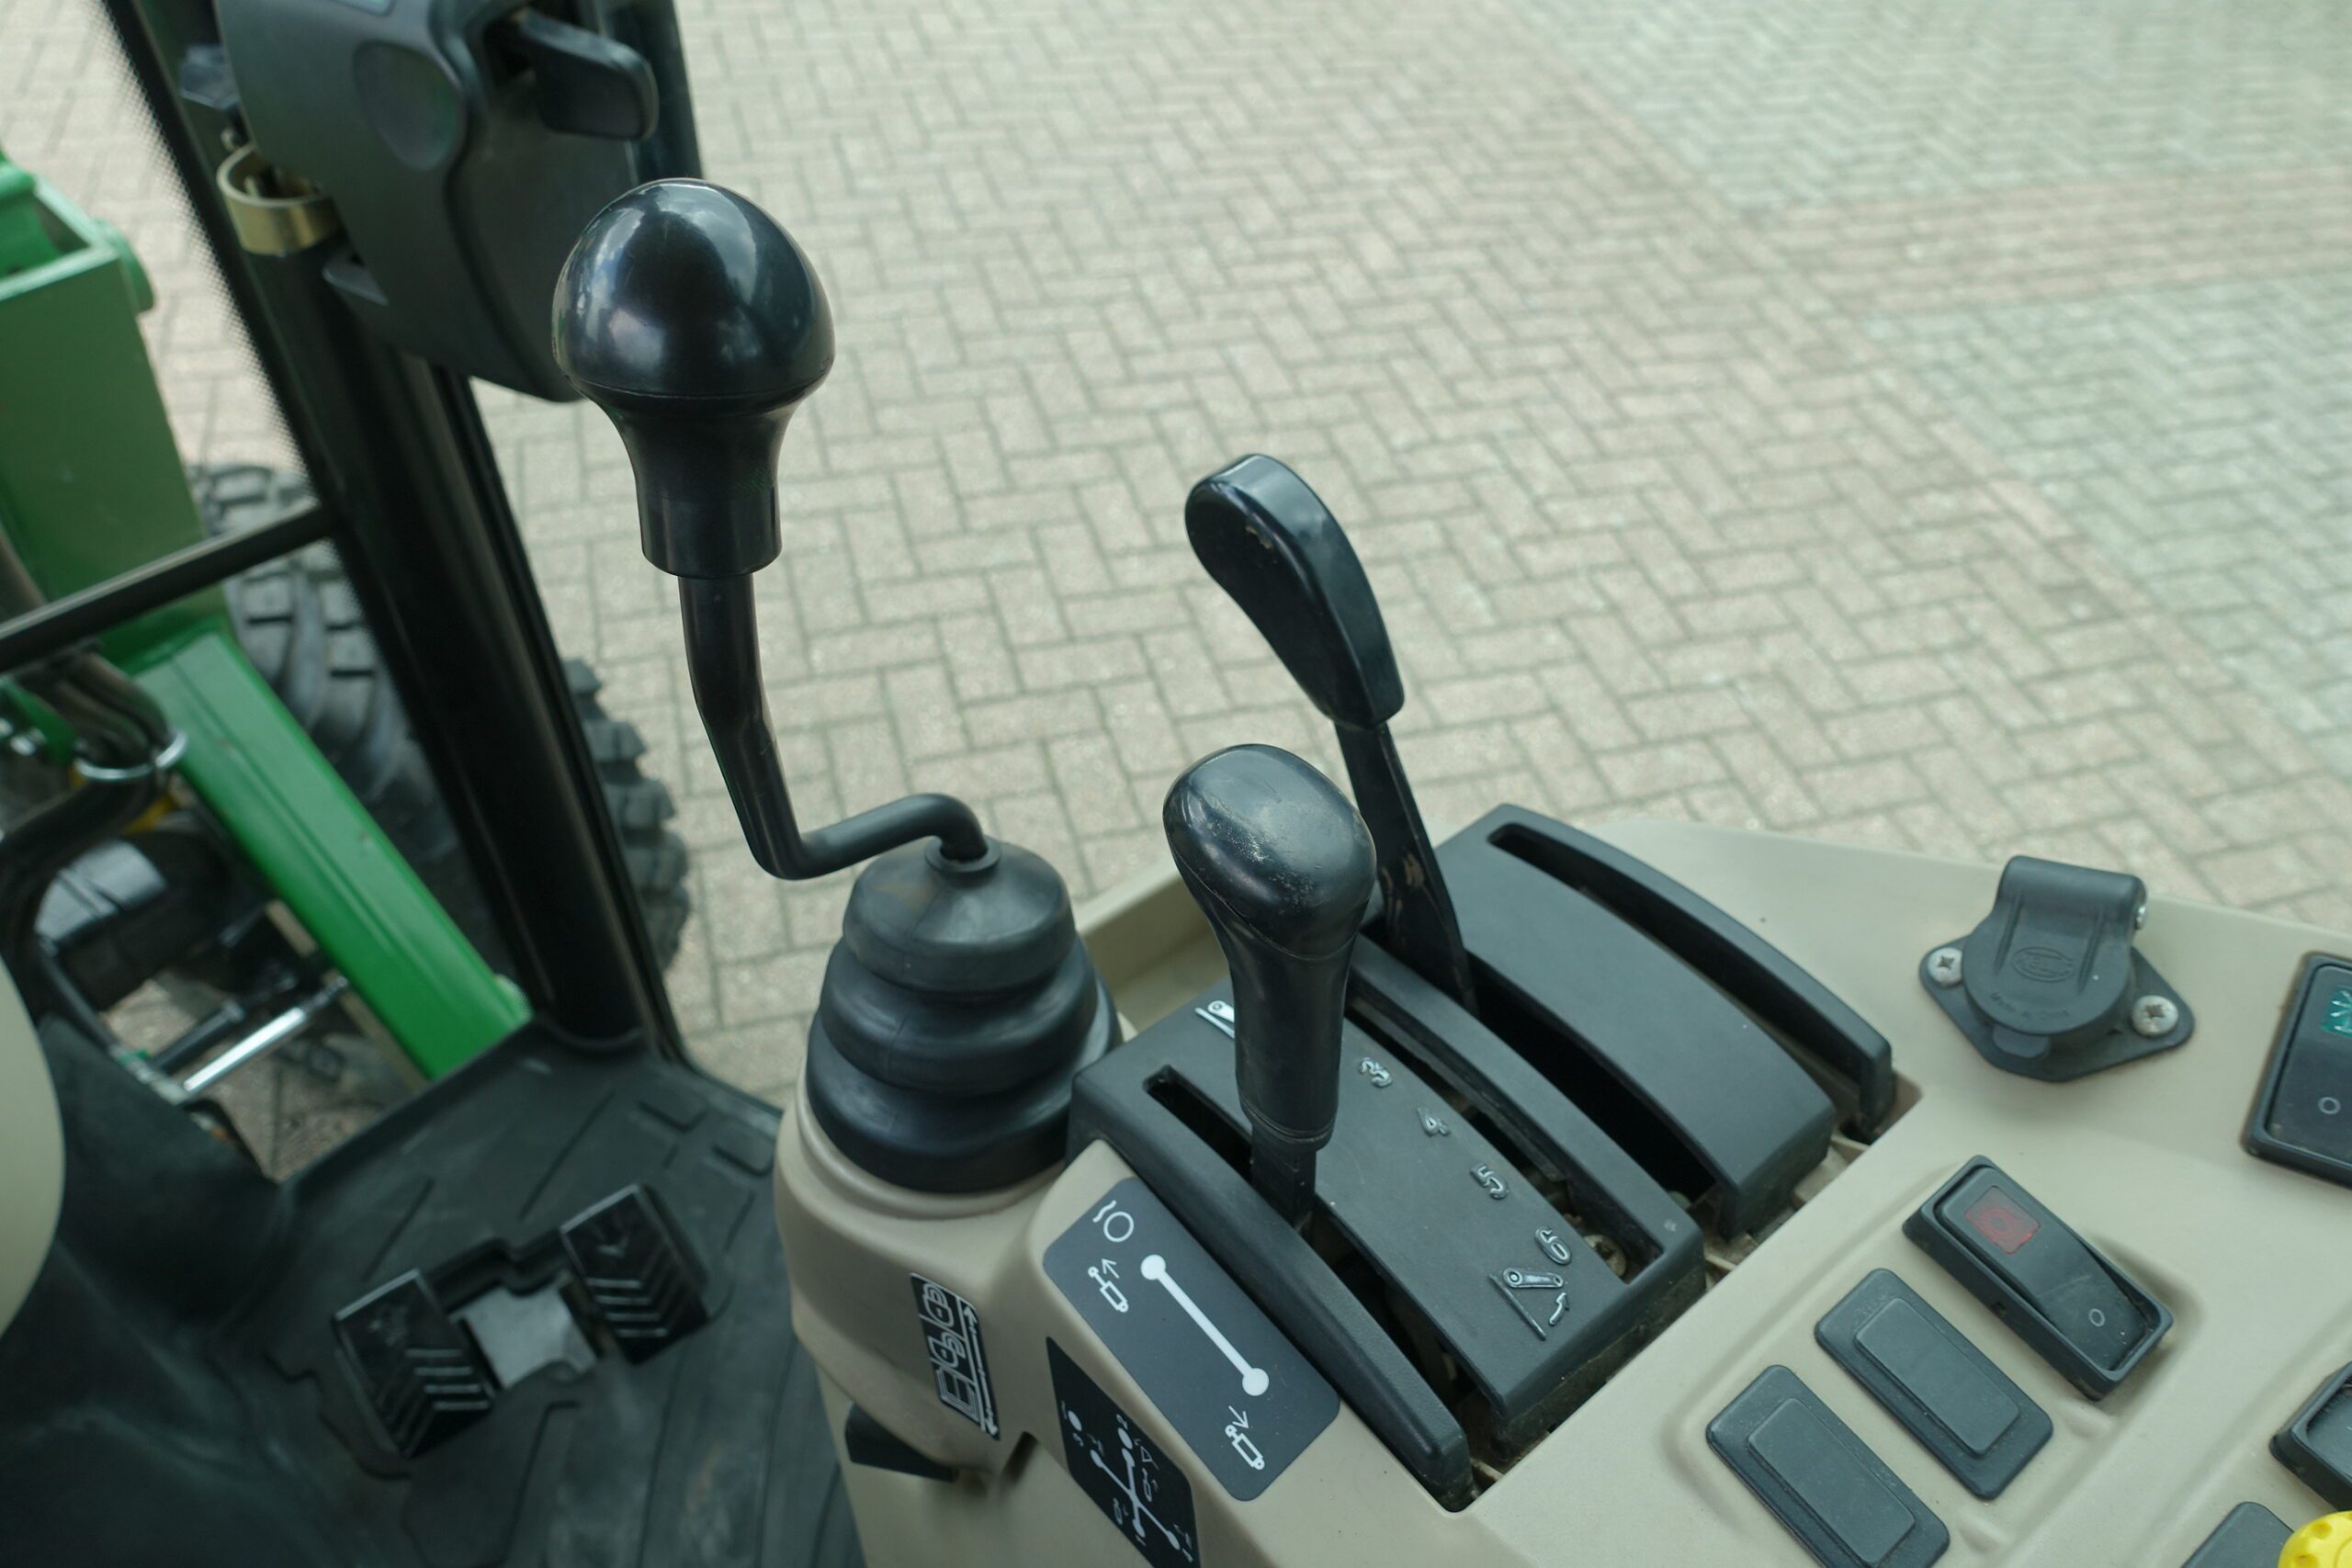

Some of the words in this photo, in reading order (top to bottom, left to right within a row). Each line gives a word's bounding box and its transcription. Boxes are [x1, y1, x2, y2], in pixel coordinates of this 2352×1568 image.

[1360, 1057, 1393, 1088] 3
[1417, 1107, 1451, 1136] 4
[1471, 1164, 1509, 1200] 5
[1534, 1226, 1572, 1265] 6
